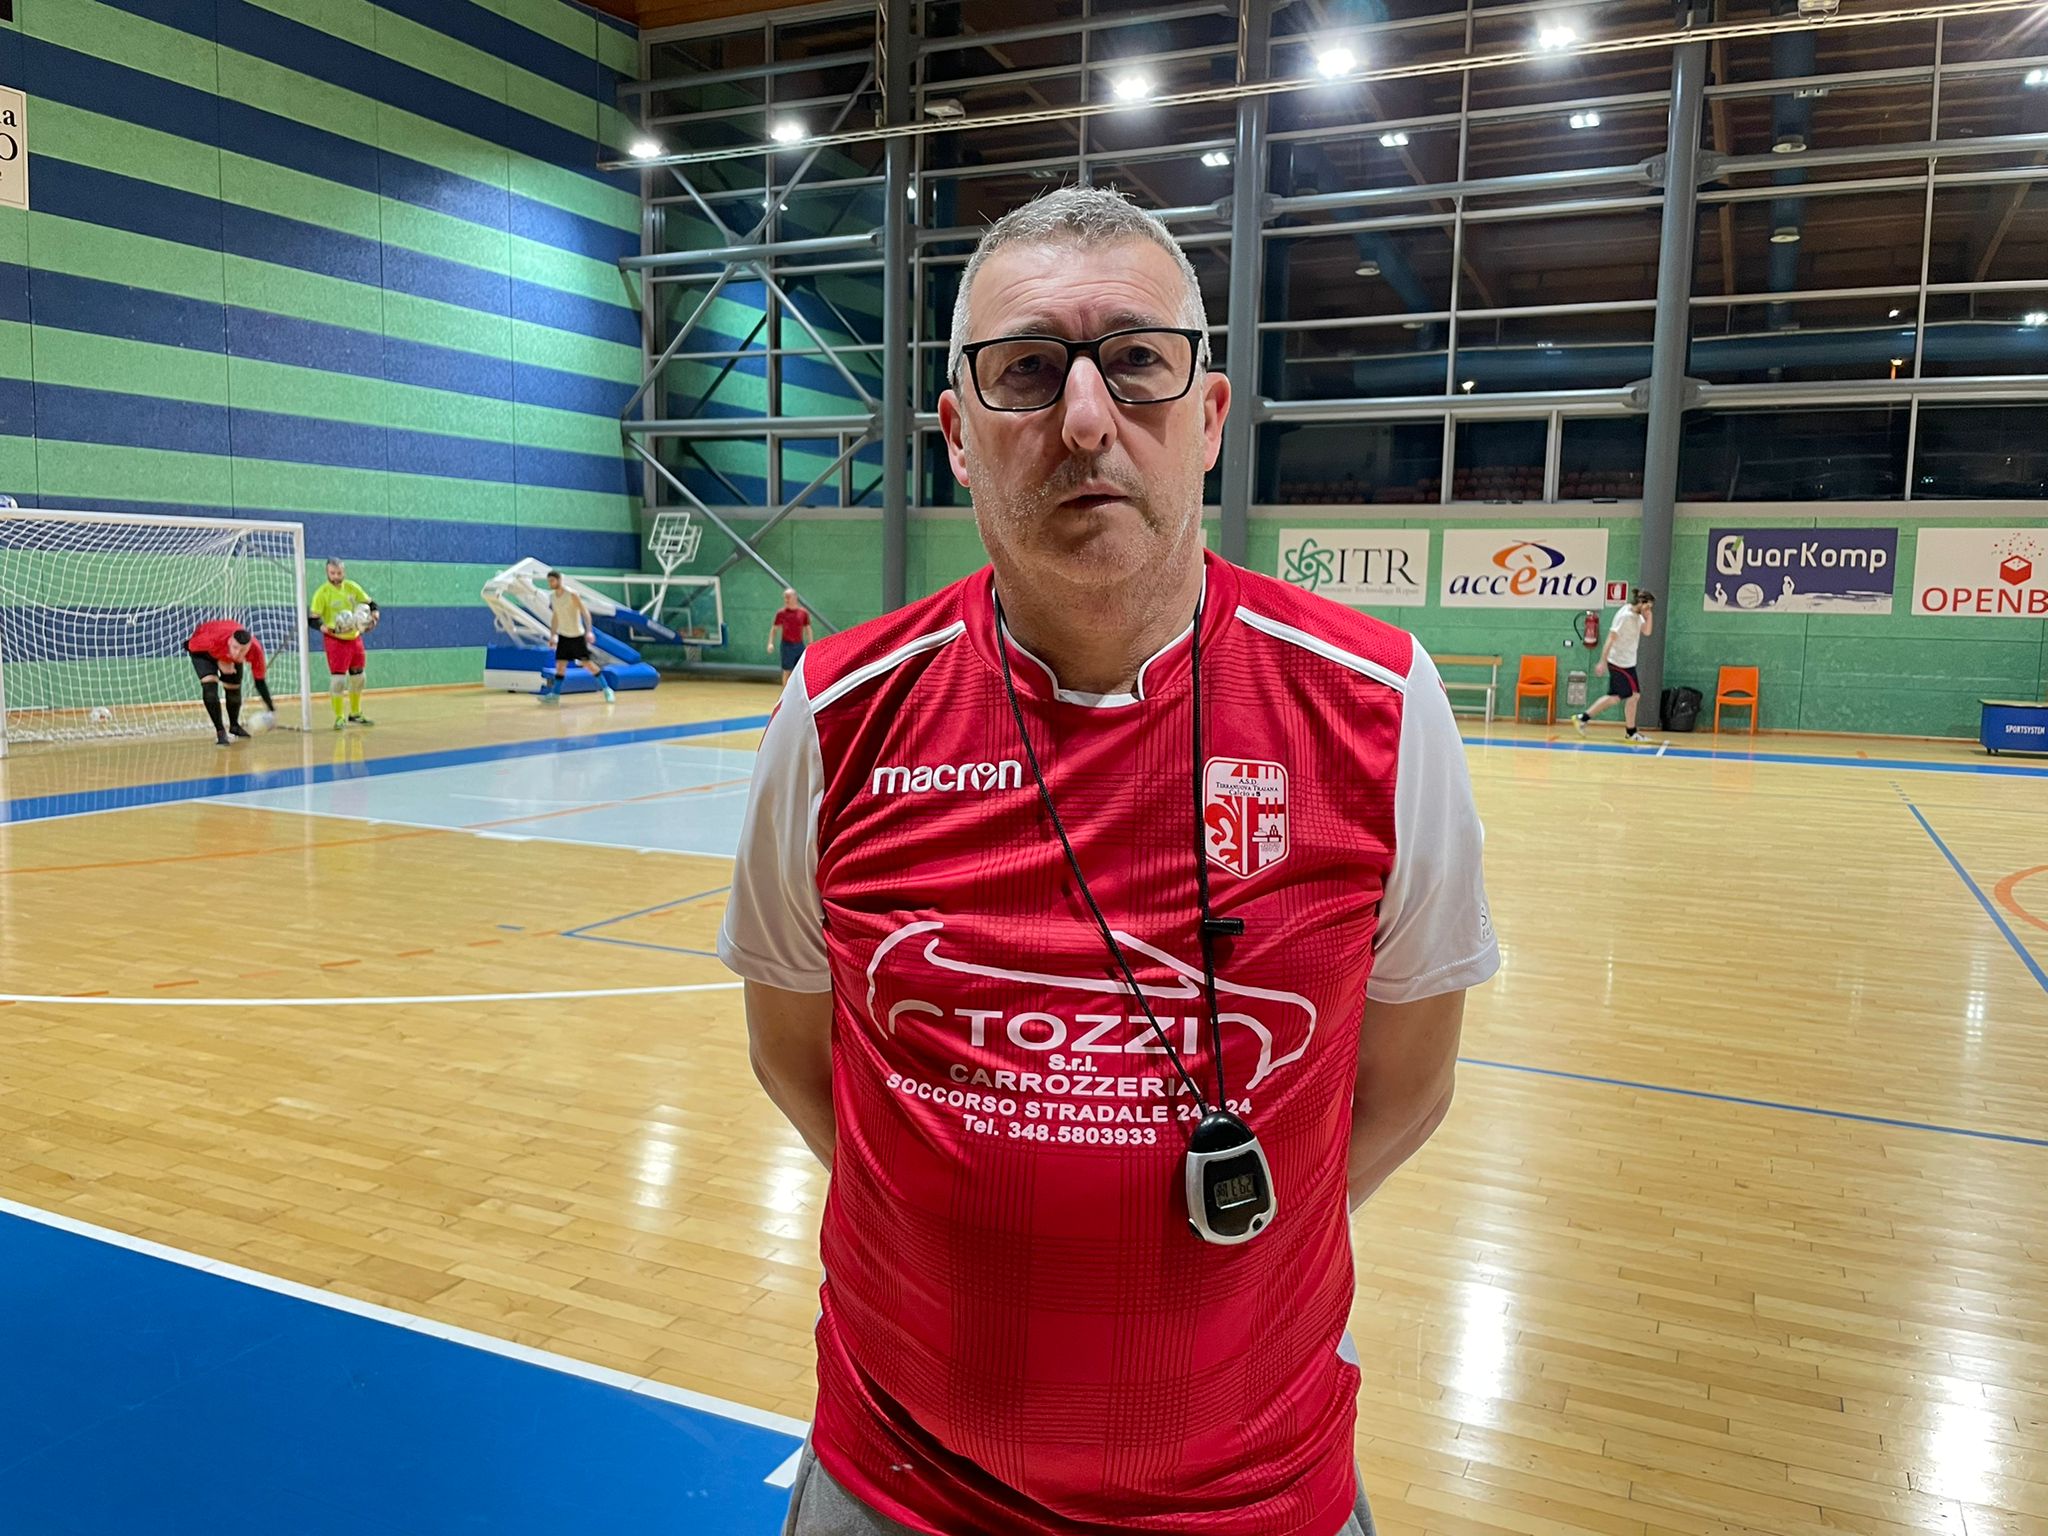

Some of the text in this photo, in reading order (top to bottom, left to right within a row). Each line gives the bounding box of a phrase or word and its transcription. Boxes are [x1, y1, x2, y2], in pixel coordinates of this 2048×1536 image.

[1337, 548, 1419, 586] ITR
[1716, 535, 1887, 575] QuarKomp
[872, 760, 1022, 795] macron
[954, 1008, 1197, 1055] TOZZI
[886, 1073, 1016, 1117] SOCCORSO
[1024, 1102, 1168, 1123] STRADALE
[950, 1063, 1201, 1097] CARROZZERIA
[963, 1113, 1157, 1145] Tel. 348.5803933
